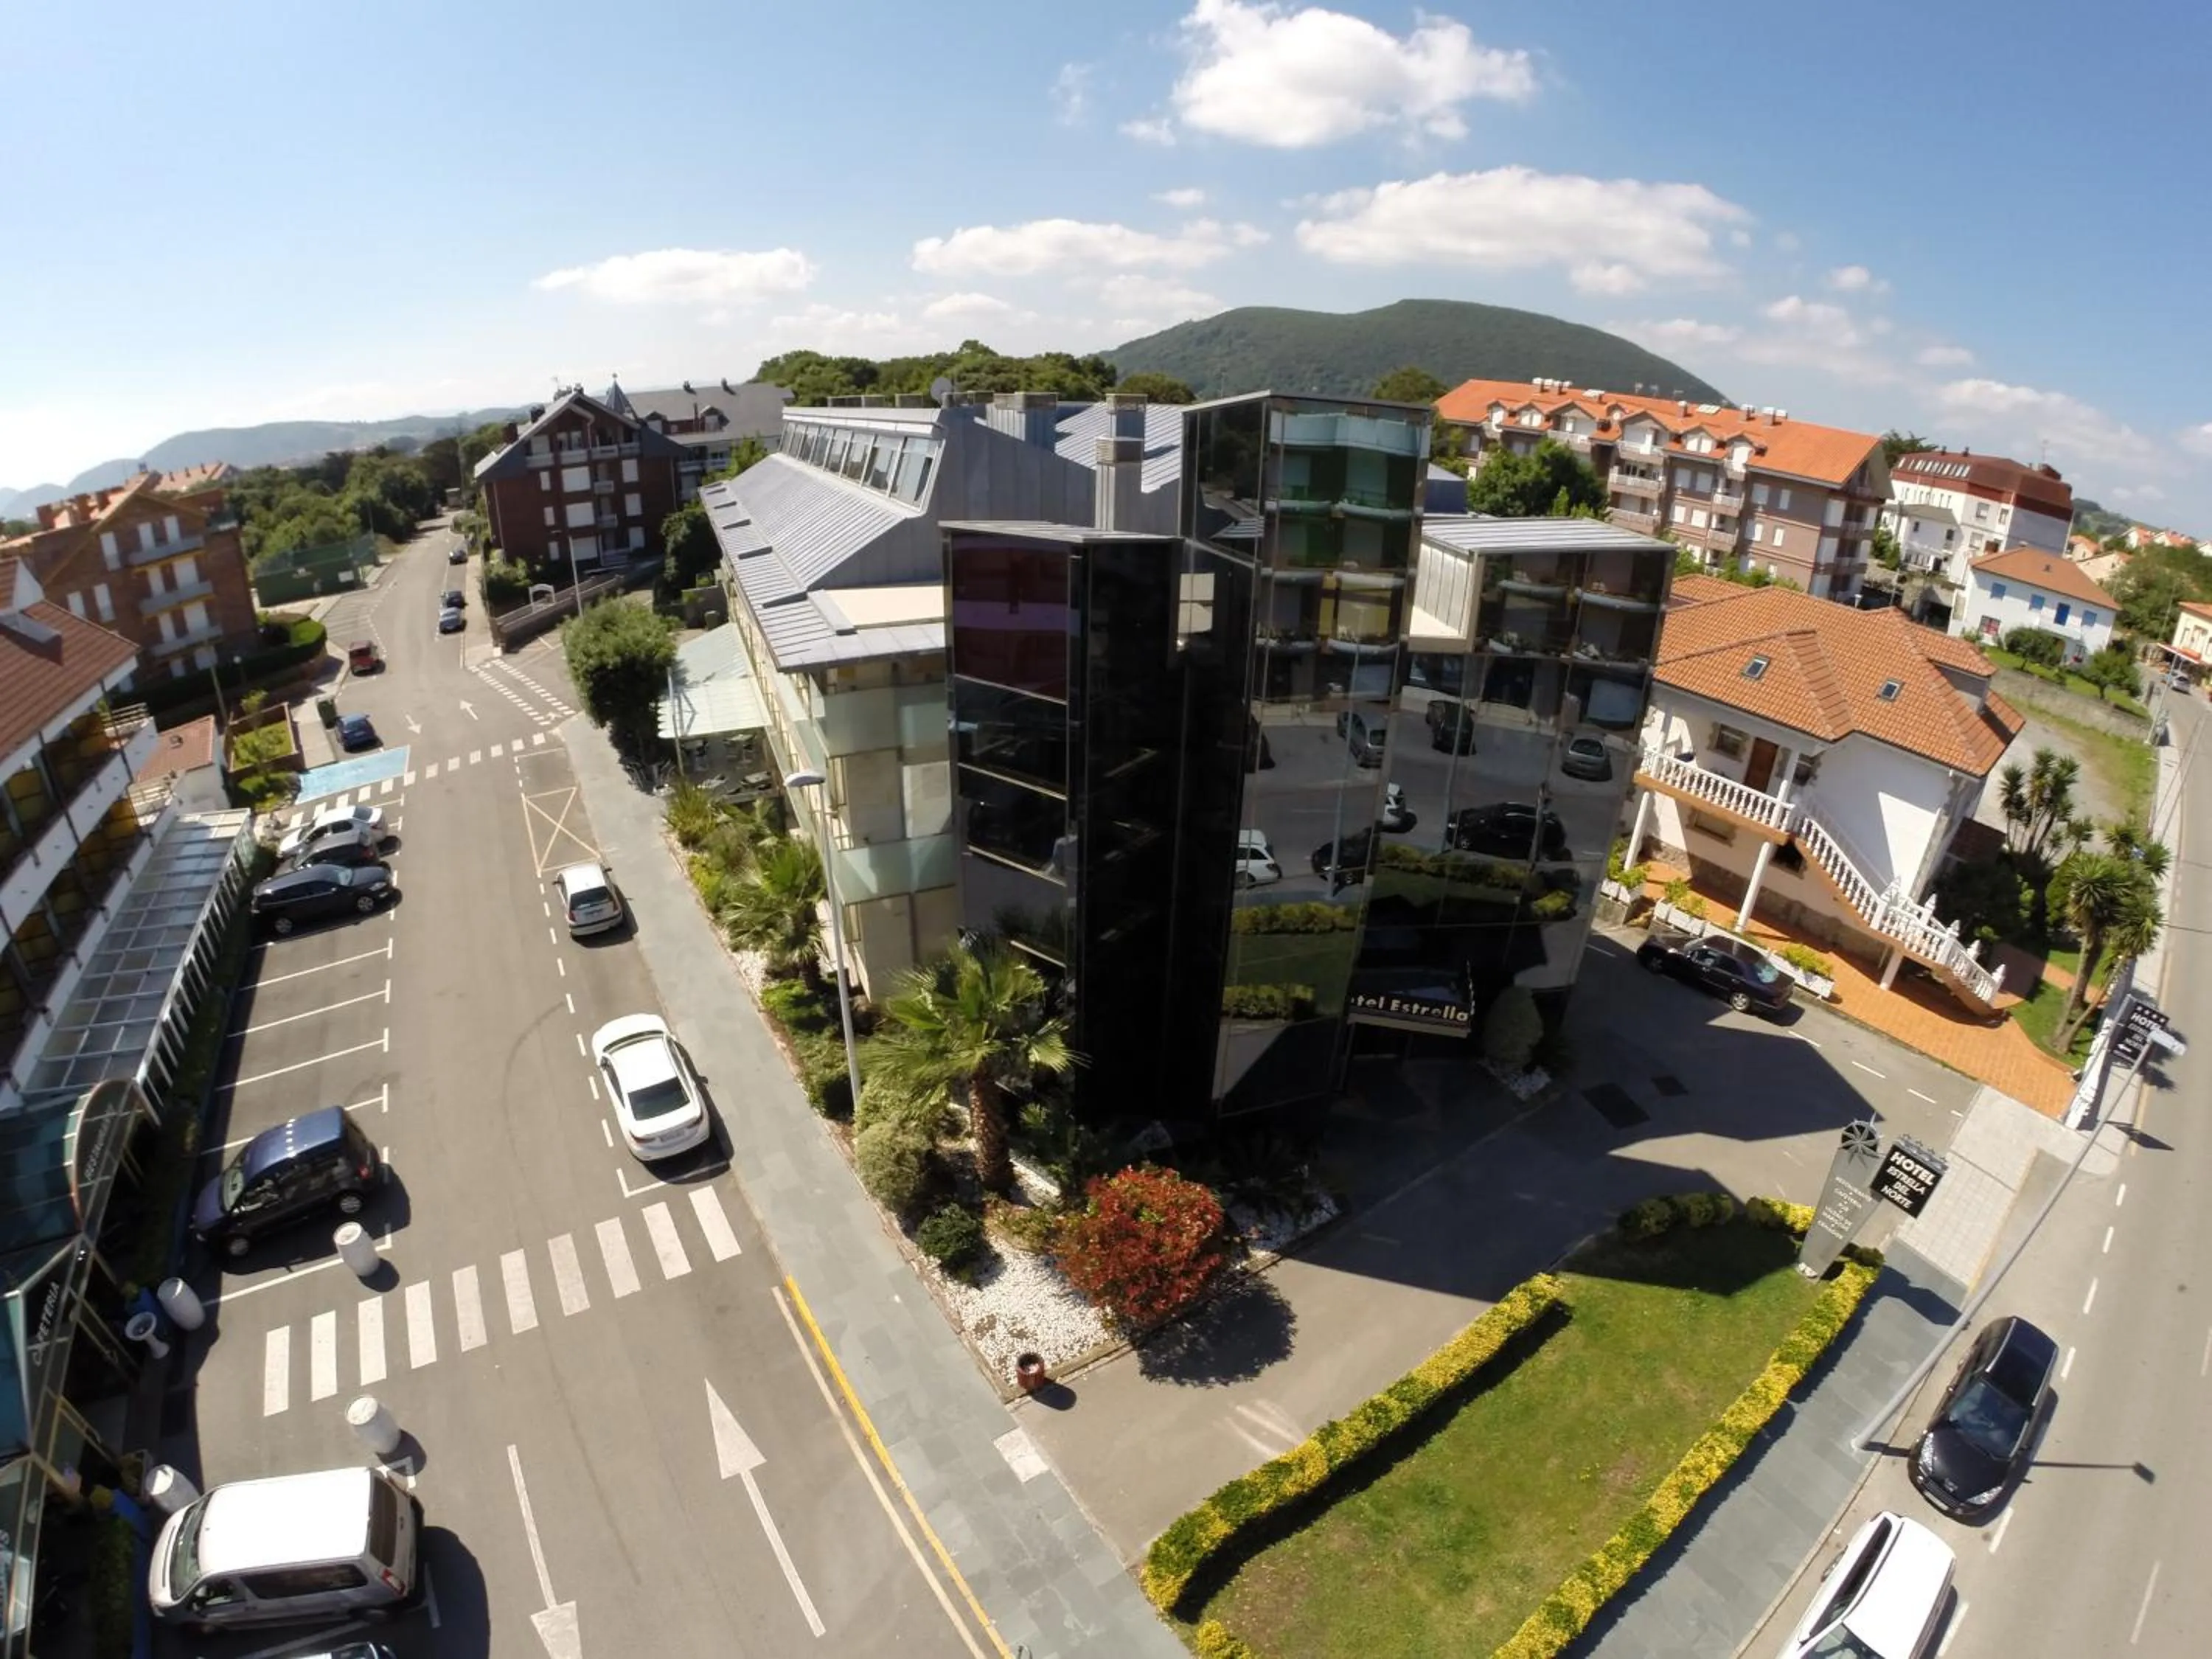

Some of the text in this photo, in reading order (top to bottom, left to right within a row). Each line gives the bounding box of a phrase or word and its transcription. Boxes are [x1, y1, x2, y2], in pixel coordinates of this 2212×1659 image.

[1351, 995, 1469, 1021] tel Estrella
[1886, 1166, 1926, 1194] ESTRELLA
[1890, 1152, 1935, 1186] HOTEL
[1880, 1185, 1914, 1208] NORTE
[1893, 1181, 1910, 1195] DEL
